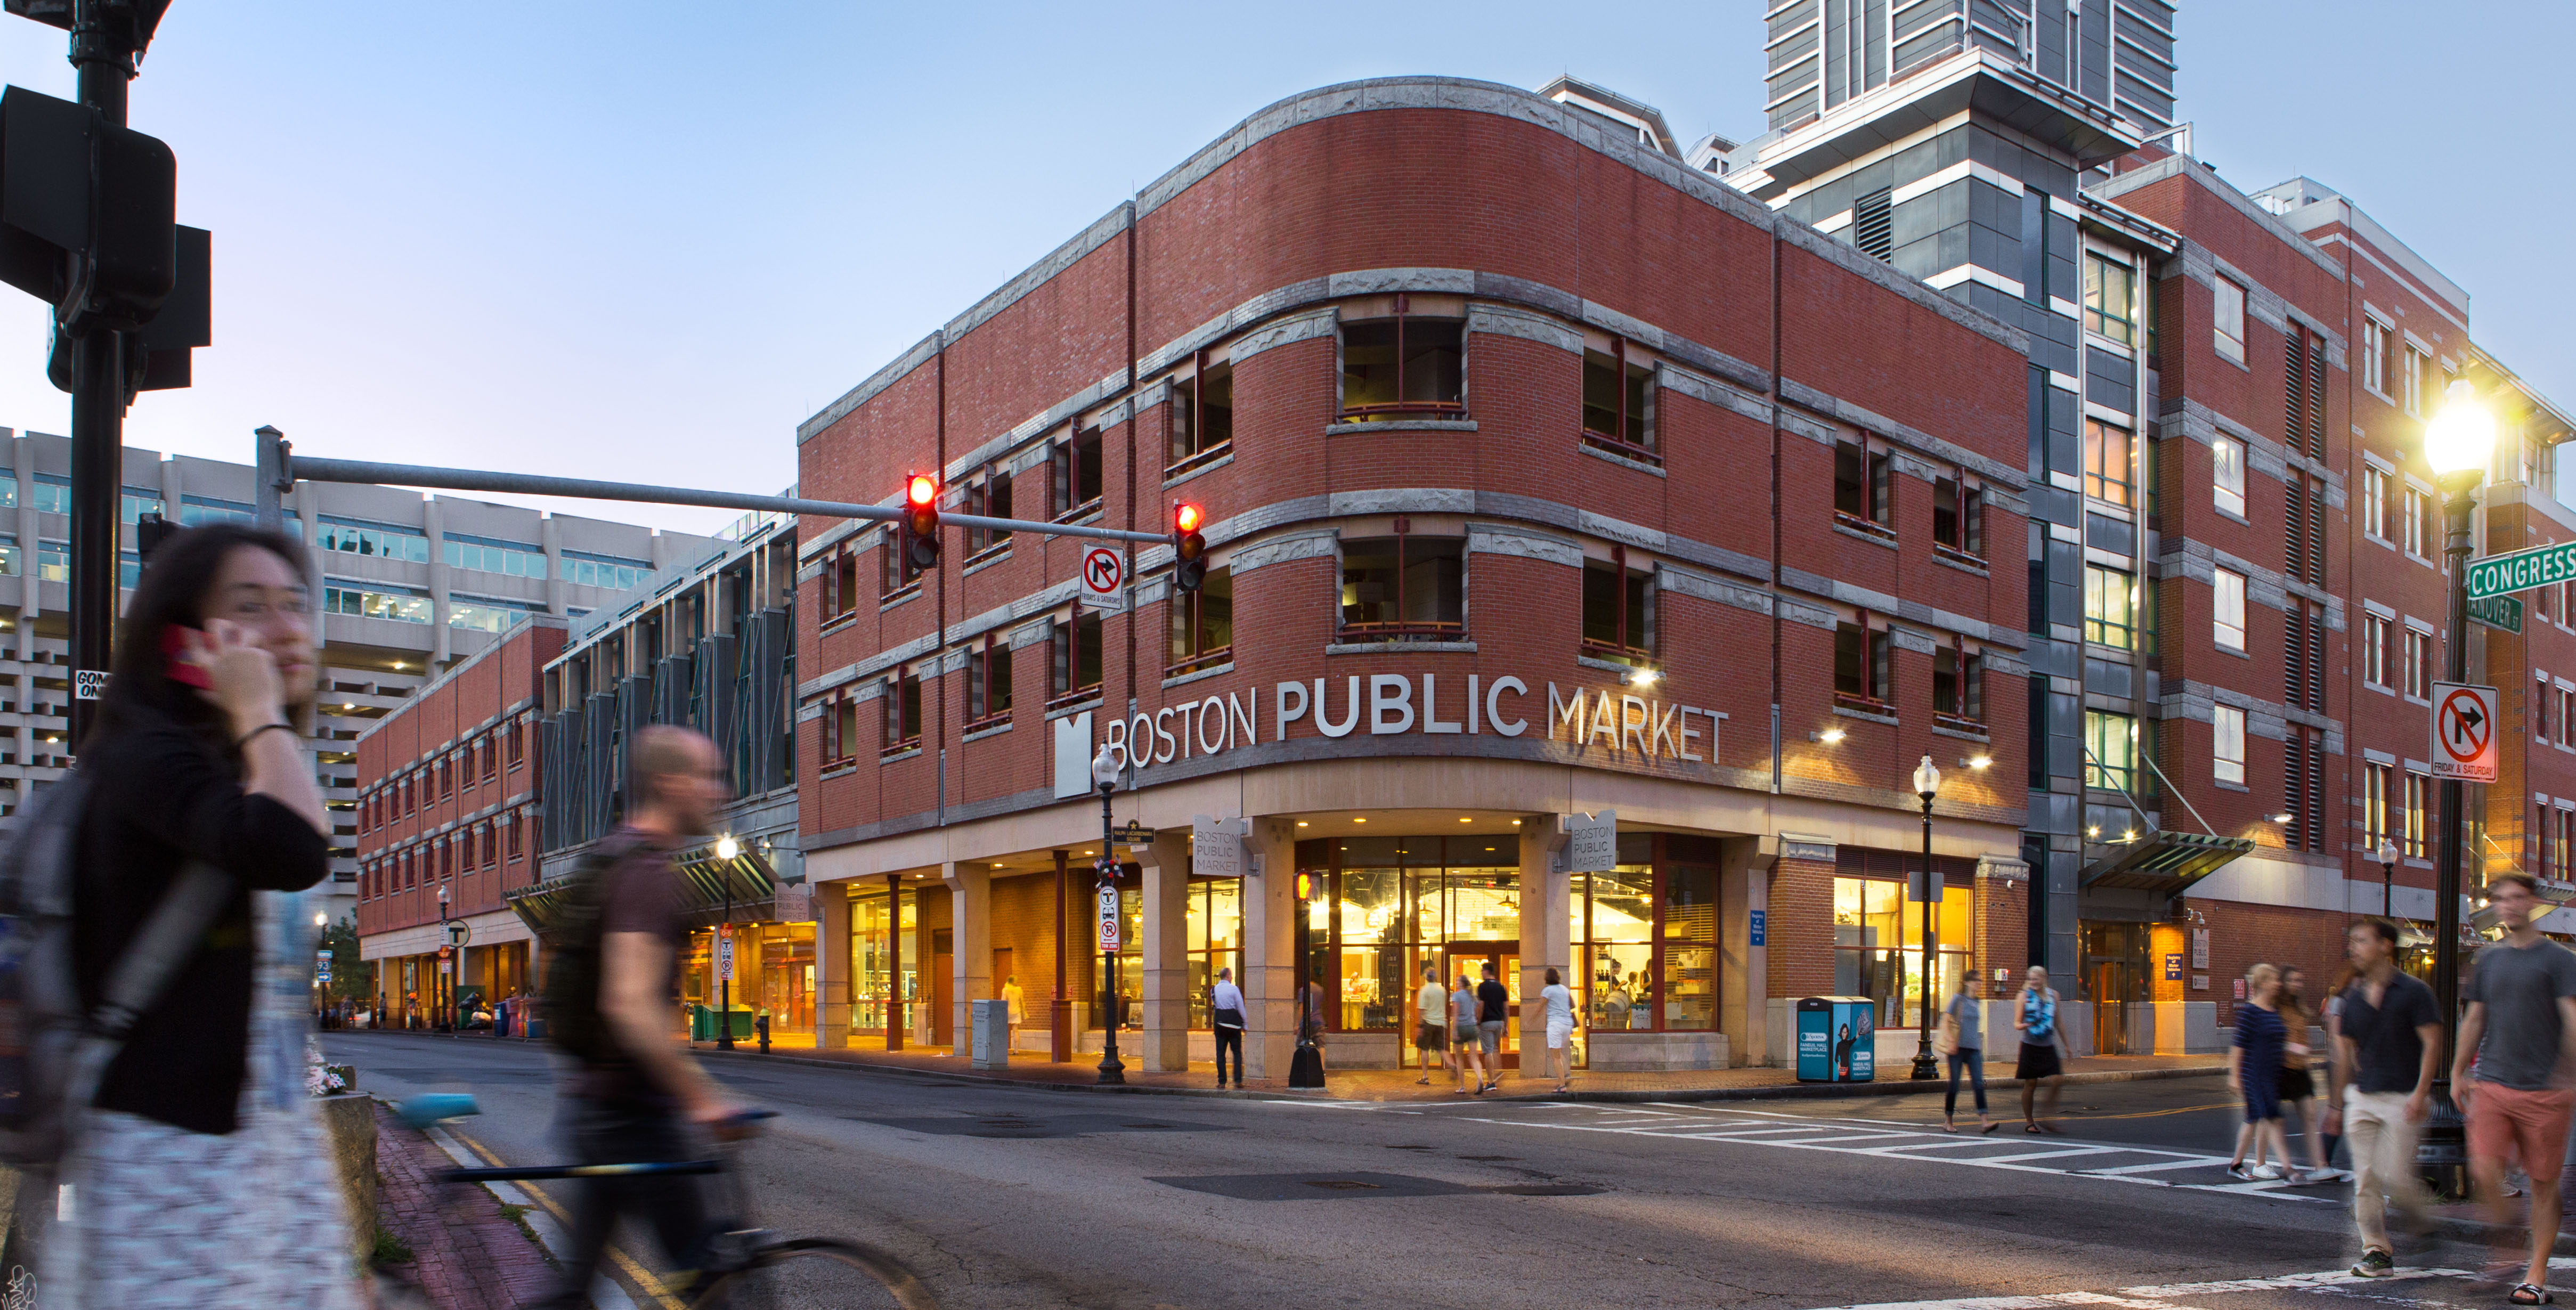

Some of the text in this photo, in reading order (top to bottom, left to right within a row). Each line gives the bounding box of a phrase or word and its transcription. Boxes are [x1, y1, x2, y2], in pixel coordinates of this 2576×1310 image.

[2472, 548, 2576, 595] CONGRESS
[2512, 616, 2518, 629] ST
[1108, 673, 1729, 771] BOSTON PUBLIC MARKET
[2434, 762, 2493, 776] FRIDAY & SATURDAY
[1197, 831, 1239, 844] BOSTON
[1574, 826, 1613, 840] BOSTON
[1197, 845, 1233, 858] PUBLIC
[1574, 841, 1608, 853] PUBLIC
[1196, 859, 1238, 872] MARKET
[1574, 855, 1613, 869] MARKET
[777, 893, 808, 901] BOSTON
[1103, 892, 1114, 902] T
[448, 927, 466, 943] T
